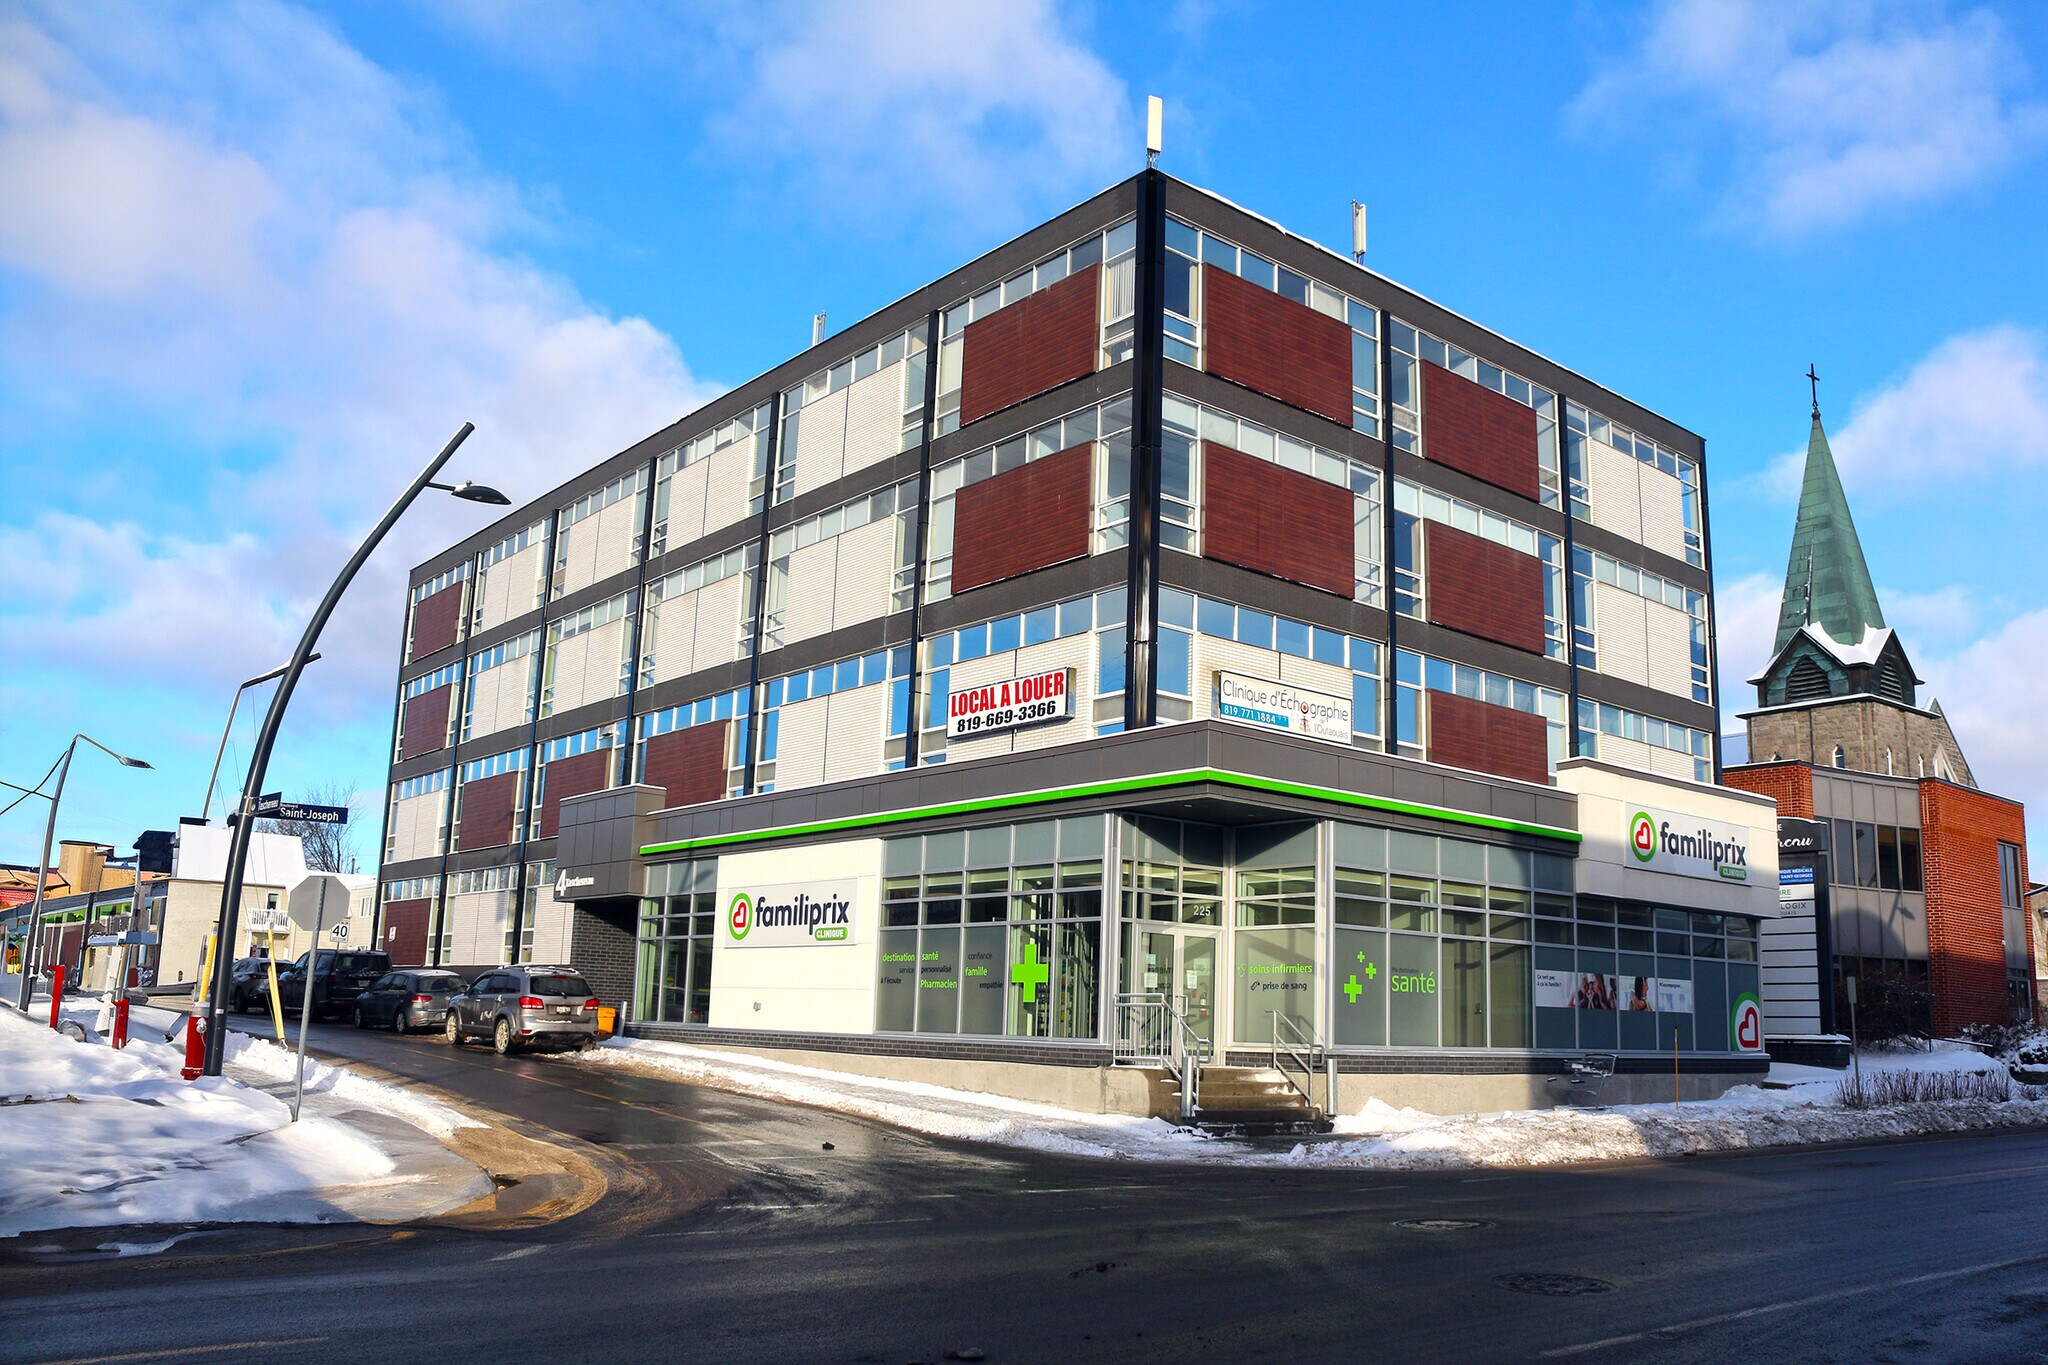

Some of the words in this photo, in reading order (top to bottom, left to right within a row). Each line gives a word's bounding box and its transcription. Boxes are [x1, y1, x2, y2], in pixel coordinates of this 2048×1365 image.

[951, 687, 997, 717] LOCAL
[1015, 672, 1065, 705] LOUER
[1222, 679, 1267, 707] Clinique
[957, 700, 1056, 733] 819-669-3366
[1223, 703, 1277, 724] 819.771.1884
[280, 807, 339, 822] Saint-Joseph
[1660, 821, 1746, 872] familiprix
[1722, 868, 1746, 879] CLINIQUE
[555, 869, 566, 896] 4
[755, 893, 850, 935] familiprix
[1193, 905, 1211, 917] 225
[332, 925, 348, 937] 40
[816, 928, 844, 939] CLINIQUE
[883, 953, 916, 962] destination
[921, 951, 939, 960] santé
[967, 952, 993, 960] confiance
[965, 966, 988, 976] famille
[1248, 964, 1270, 974] soins
[1272, 963, 1313, 973] infirmiers
[920, 978, 958, 989] Pharmacien
[1262, 982, 1280, 991] prise
[1281, 981, 1290, 990] de
[1290, 982, 1308, 992] sang
[1391, 971, 1436, 993] santé
